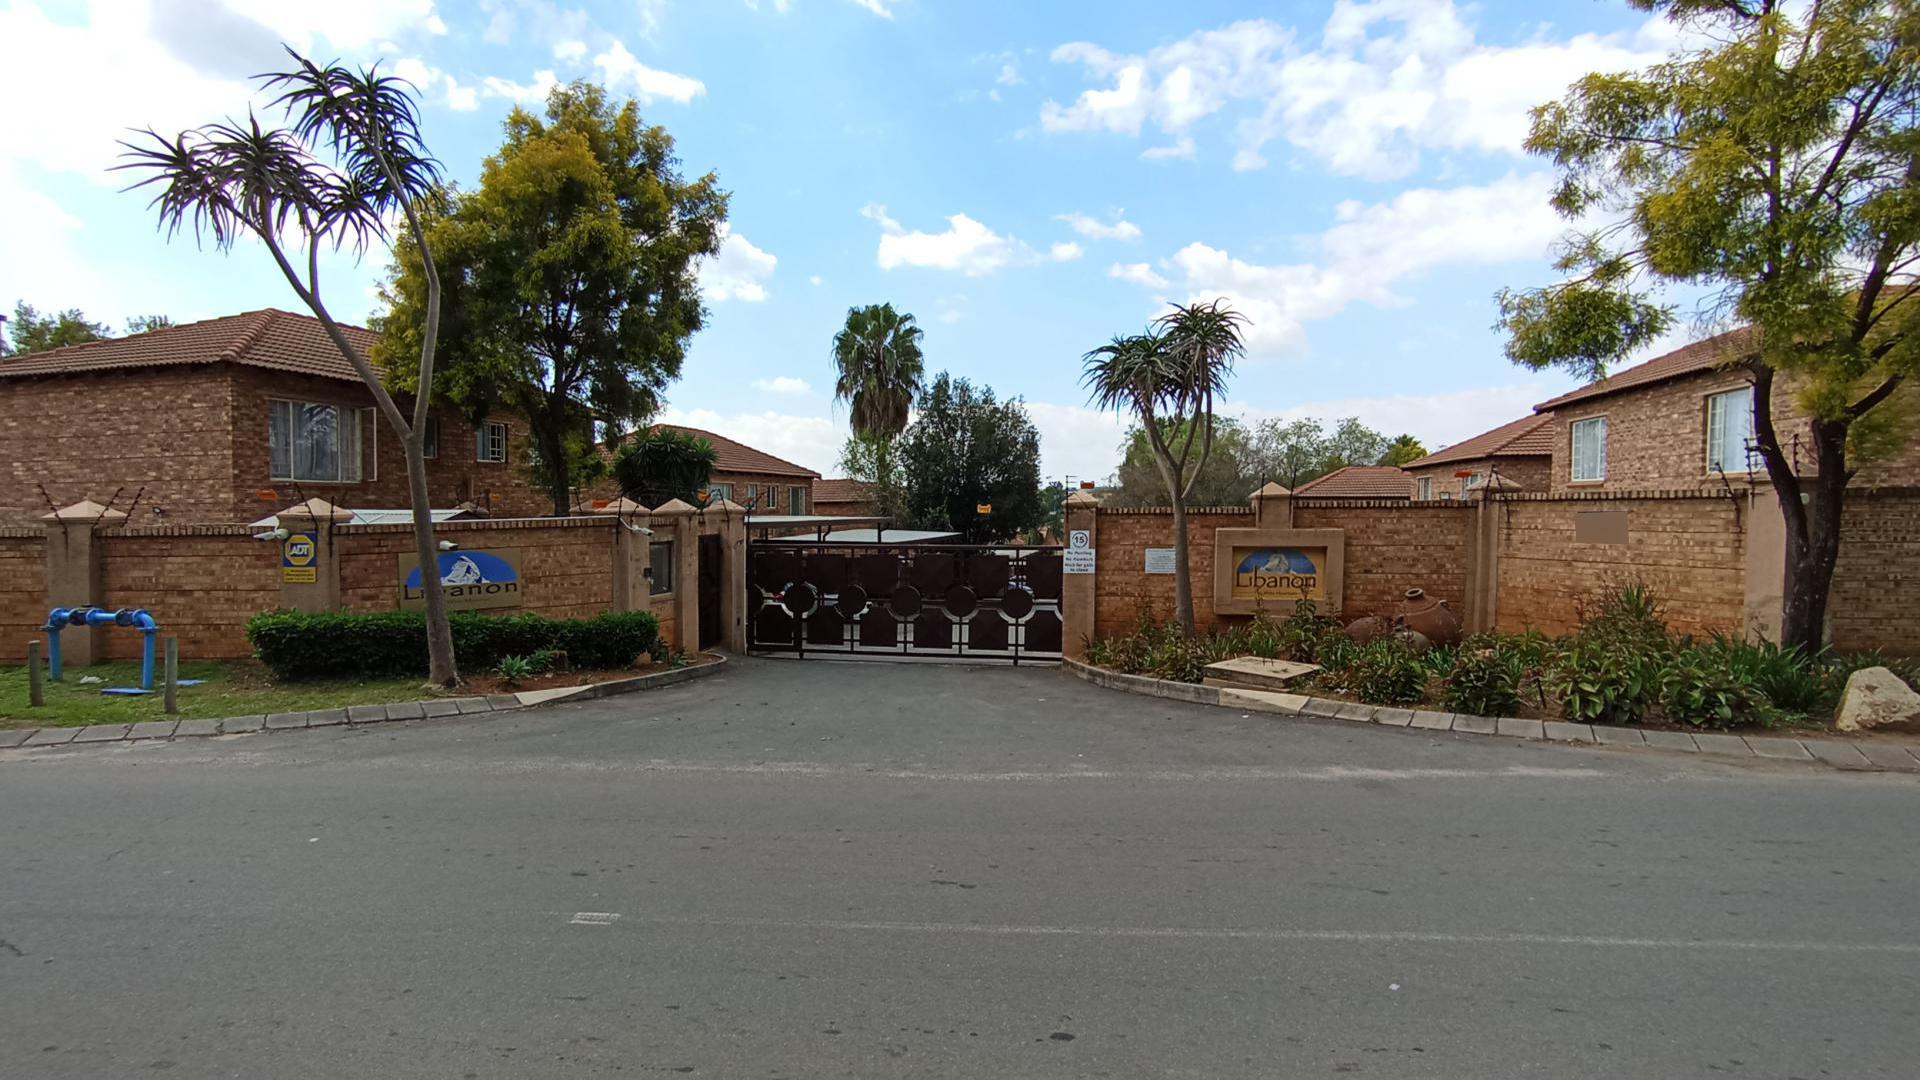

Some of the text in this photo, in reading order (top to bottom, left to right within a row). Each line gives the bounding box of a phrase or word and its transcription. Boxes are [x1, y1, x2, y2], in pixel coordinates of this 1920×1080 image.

[1075, 536, 1085, 544] 15
[290, 544, 309, 555] ADT
[1236, 564, 1316, 588] Libanon
[404, 582, 517, 600] Lianon
